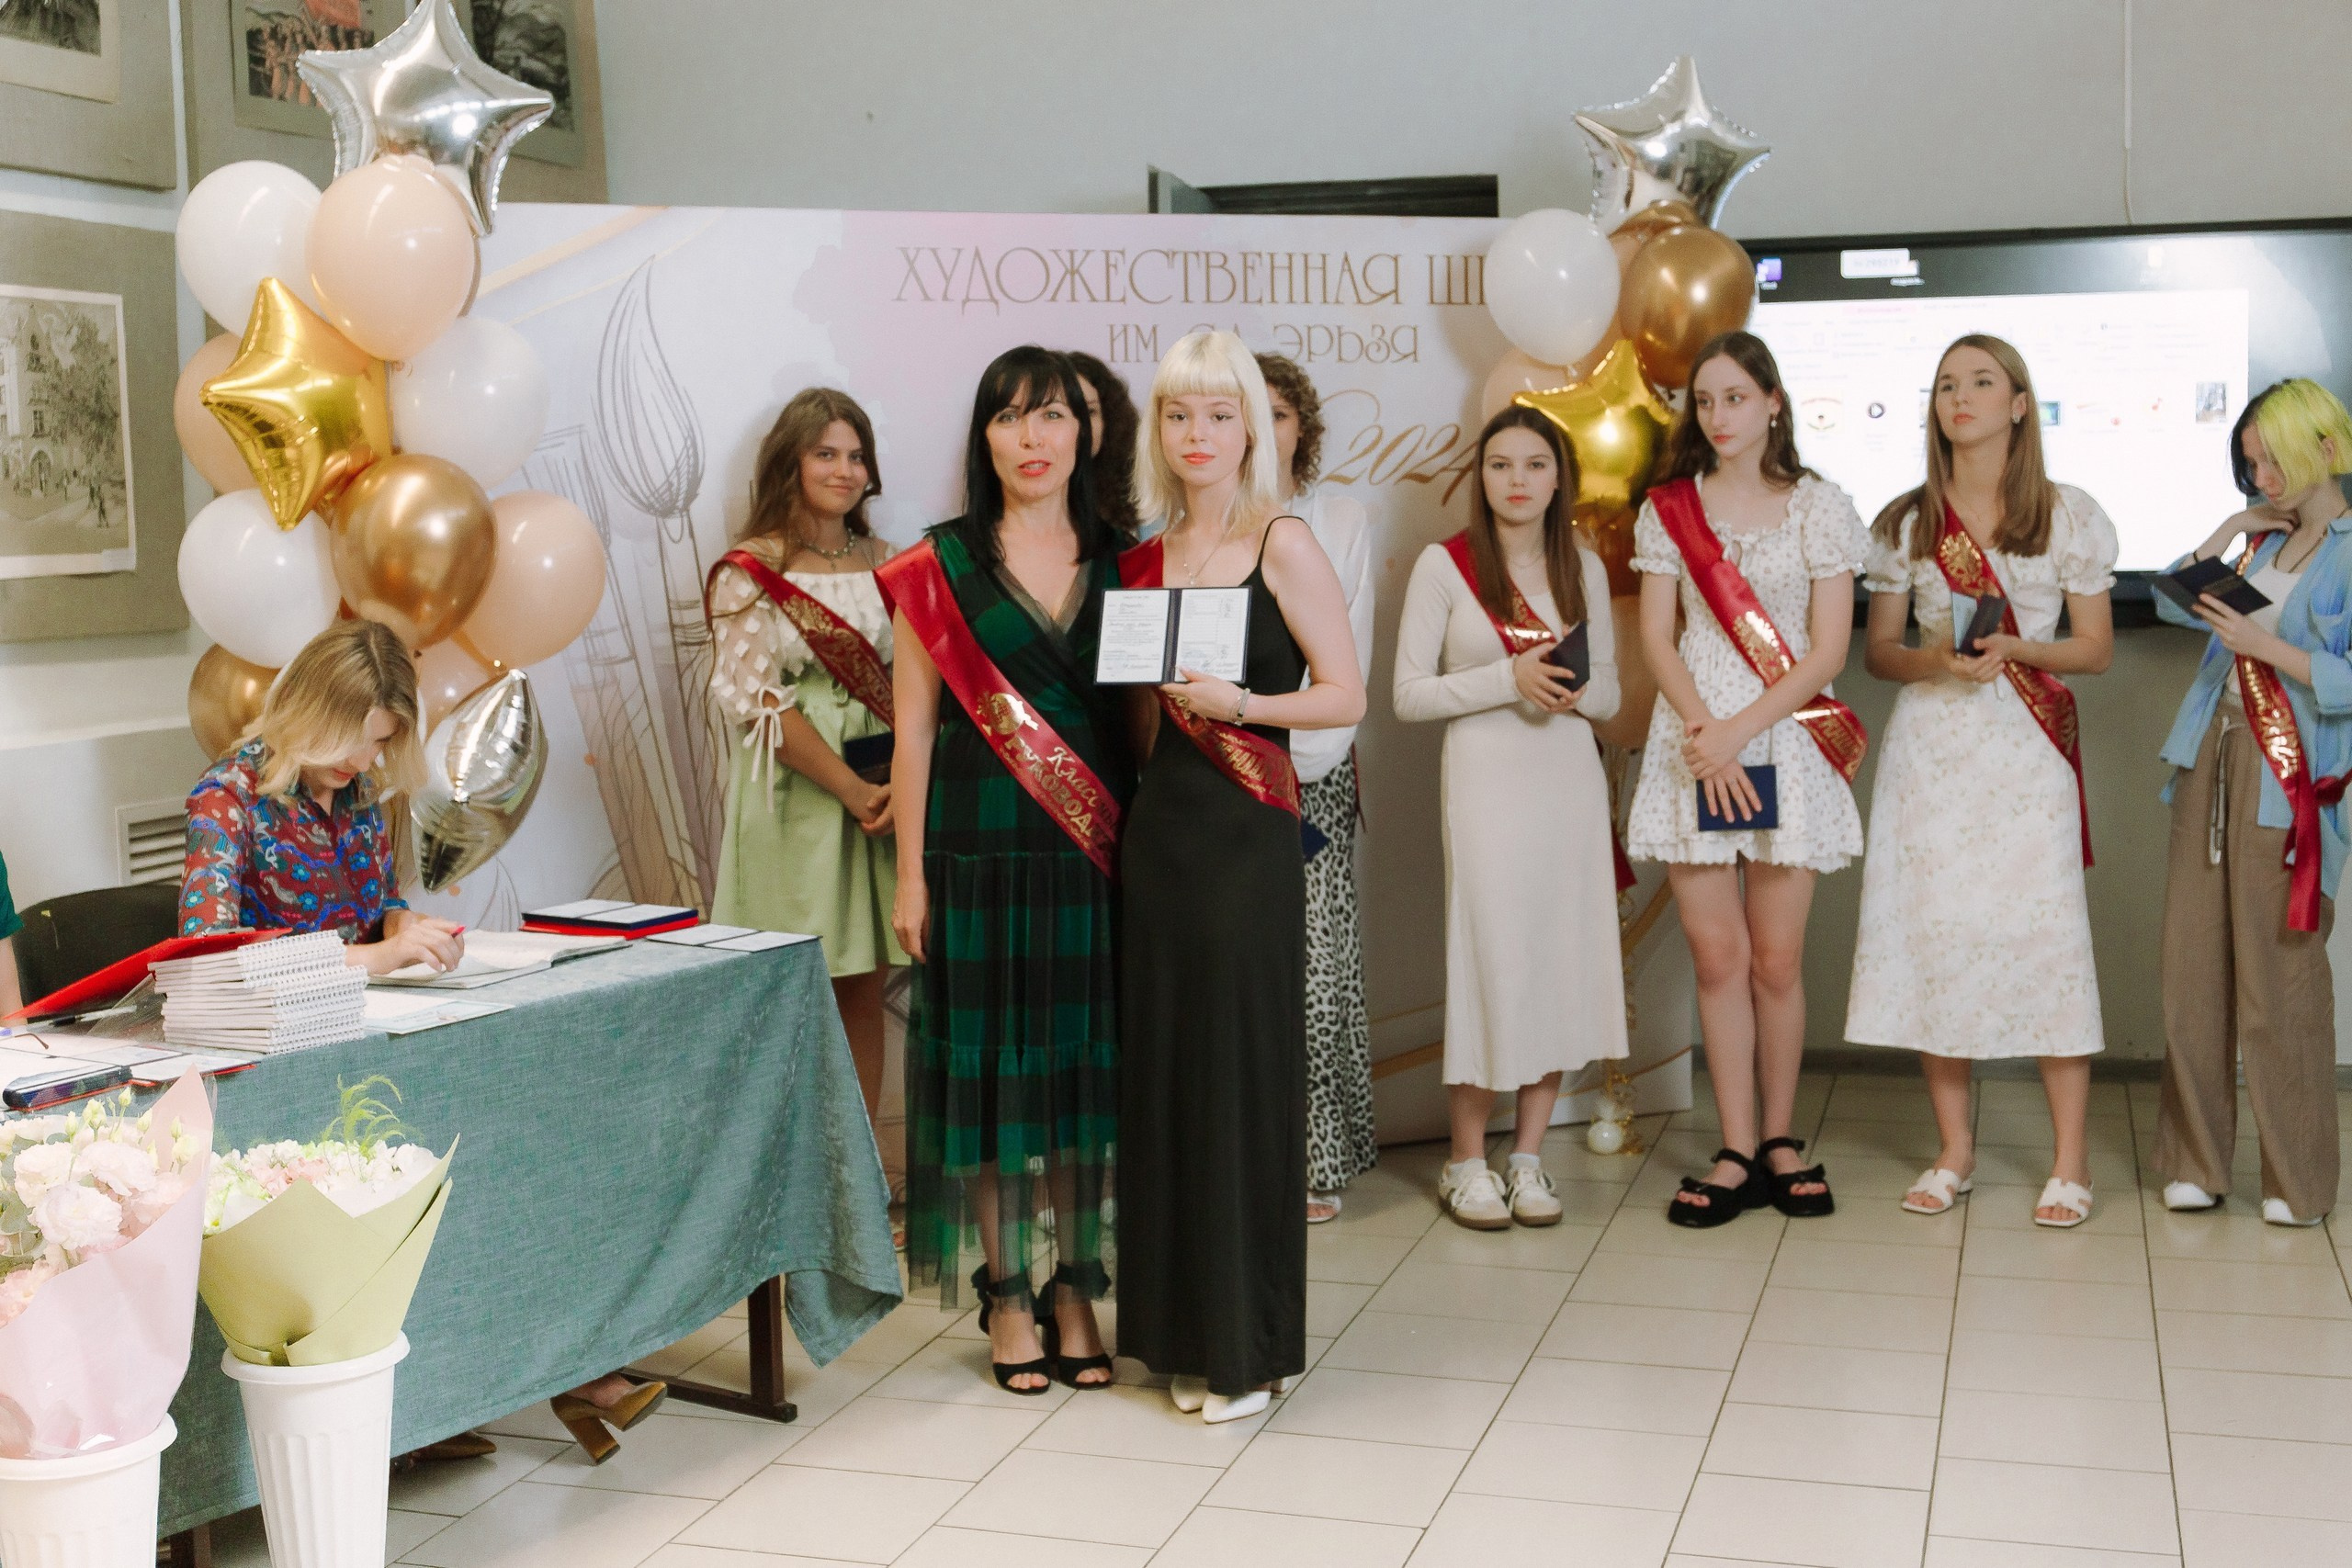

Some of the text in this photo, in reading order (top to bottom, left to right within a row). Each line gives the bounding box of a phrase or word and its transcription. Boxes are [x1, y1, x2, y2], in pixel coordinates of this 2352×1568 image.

[891, 245, 1404, 317] ХУДОЖЕСТВЕННАЯ
[1273, 322, 1420, 365] ЭРЬЗЯ
[1317, 423, 1478, 507] 2024
